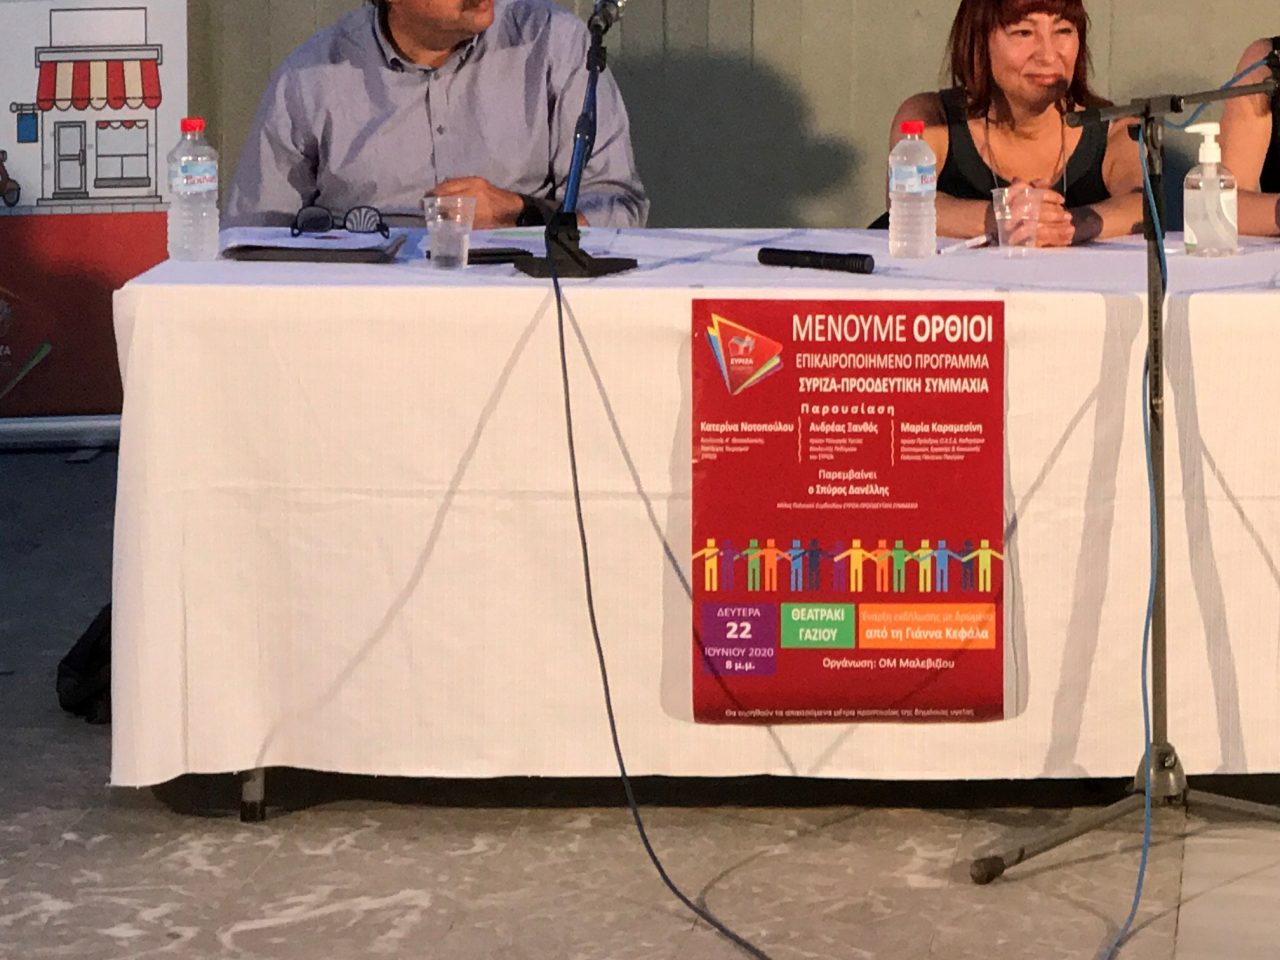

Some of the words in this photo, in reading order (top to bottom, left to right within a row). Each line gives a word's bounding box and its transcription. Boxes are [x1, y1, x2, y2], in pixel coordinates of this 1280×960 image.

[792, 314, 906, 342] ΜΕΝΟΥΜΕ
[912, 315, 993, 342] ΟΡΘΙΟΙ
[796, 353, 912, 369] ΕΠΙΚΑΙΡΟΠΟΙΗΜΕΝΟ
[915, 354, 989, 369] ΠΡΟΓΡΑΜΜΑ
[798, 377, 922, 393] ΣΥΡΙΖΑ-ΠΡΟΟΔΕΥΤΙΚΗ
[925, 377, 989, 393] ΣΥΜΜΑΧΙΑ
[801, 402, 895, 417] Παρουσίαση
[700, 420, 739, 433] Κατερίνα
[740, 421, 794, 432] Νοτοπούλου
[809, 422, 846, 434] Ανδρέας
[847, 422, 878, 434] Ξανθός
[900, 422, 929, 434] Μαρία
[931, 422, 983, 434] Καραμεσίνη
[818, 469, 877, 481] Παρεμβαίνει
[717, 608, 761, 617] ΔΕΥΤΕΡΑ
[791, 608, 845, 621] ΘΕΑΤΡΑΚΙ
[726, 621, 752, 639] 22
[799, 628, 838, 641] ΓΑΖΙΟΥ
[865, 626, 888, 639] από
[891, 628, 903, 641] τη
[906, 626, 942, 639] Γιάννα
[945, 626, 989, 642] Κεφάλα
[705, 647, 746, 657] ΙΟΥΝΙΟΥ
[748, 647, 774, 657] 2020
[725, 660, 732, 669] 8
[822, 657, 876, 670] Οργάνωση:
[878, 658, 897, 668] ΟΜ
